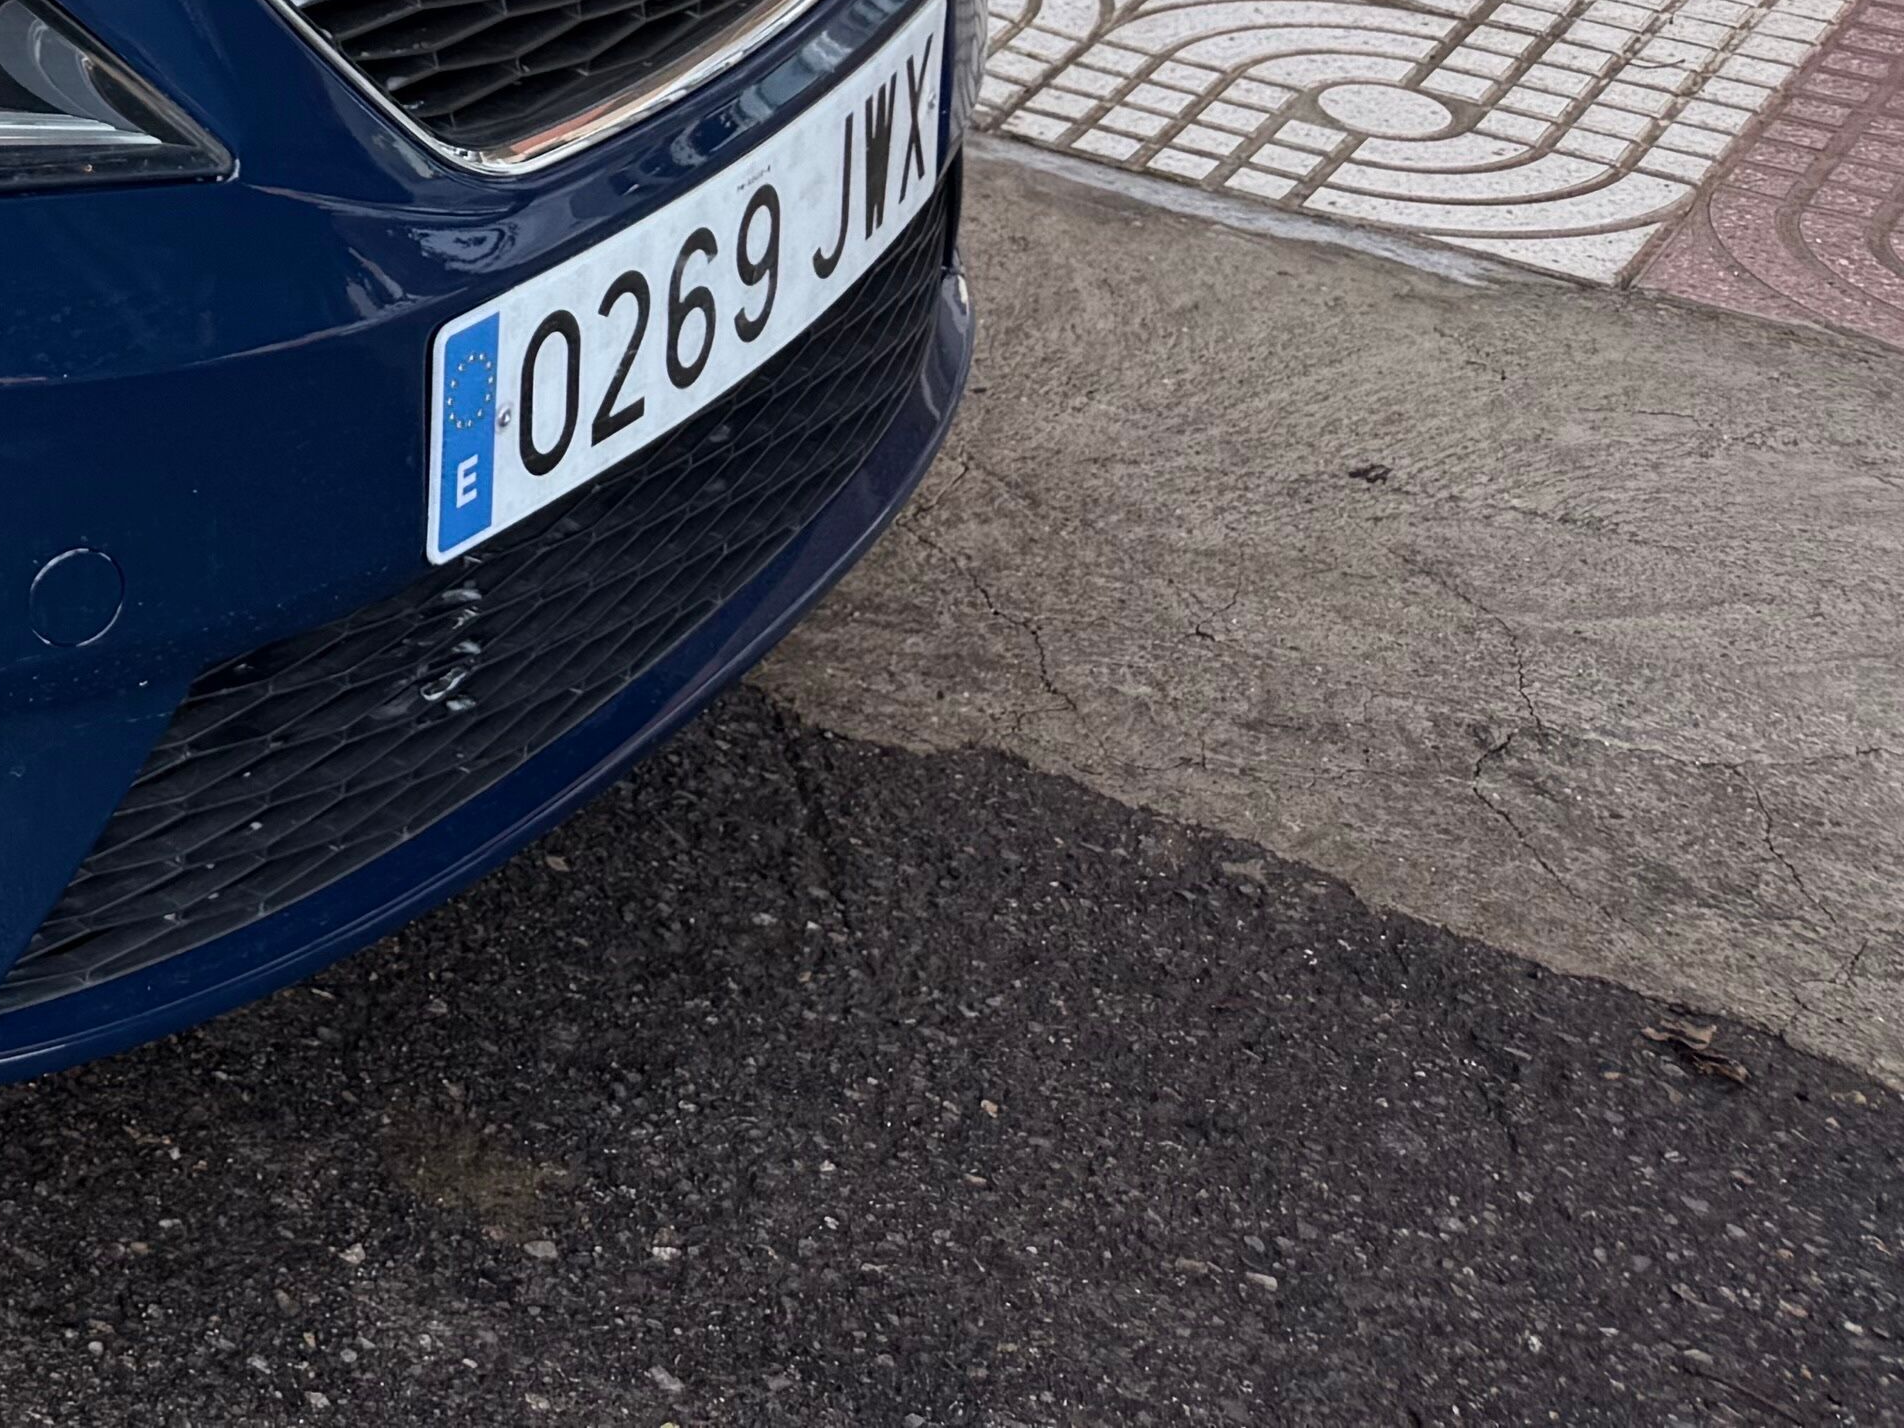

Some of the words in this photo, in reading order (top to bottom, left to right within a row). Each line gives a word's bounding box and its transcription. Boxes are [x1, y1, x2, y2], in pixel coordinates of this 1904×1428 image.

[518, 183, 781, 477] 0269
[812, 33, 934, 280] JWX
[455, 453, 478, 509] E
